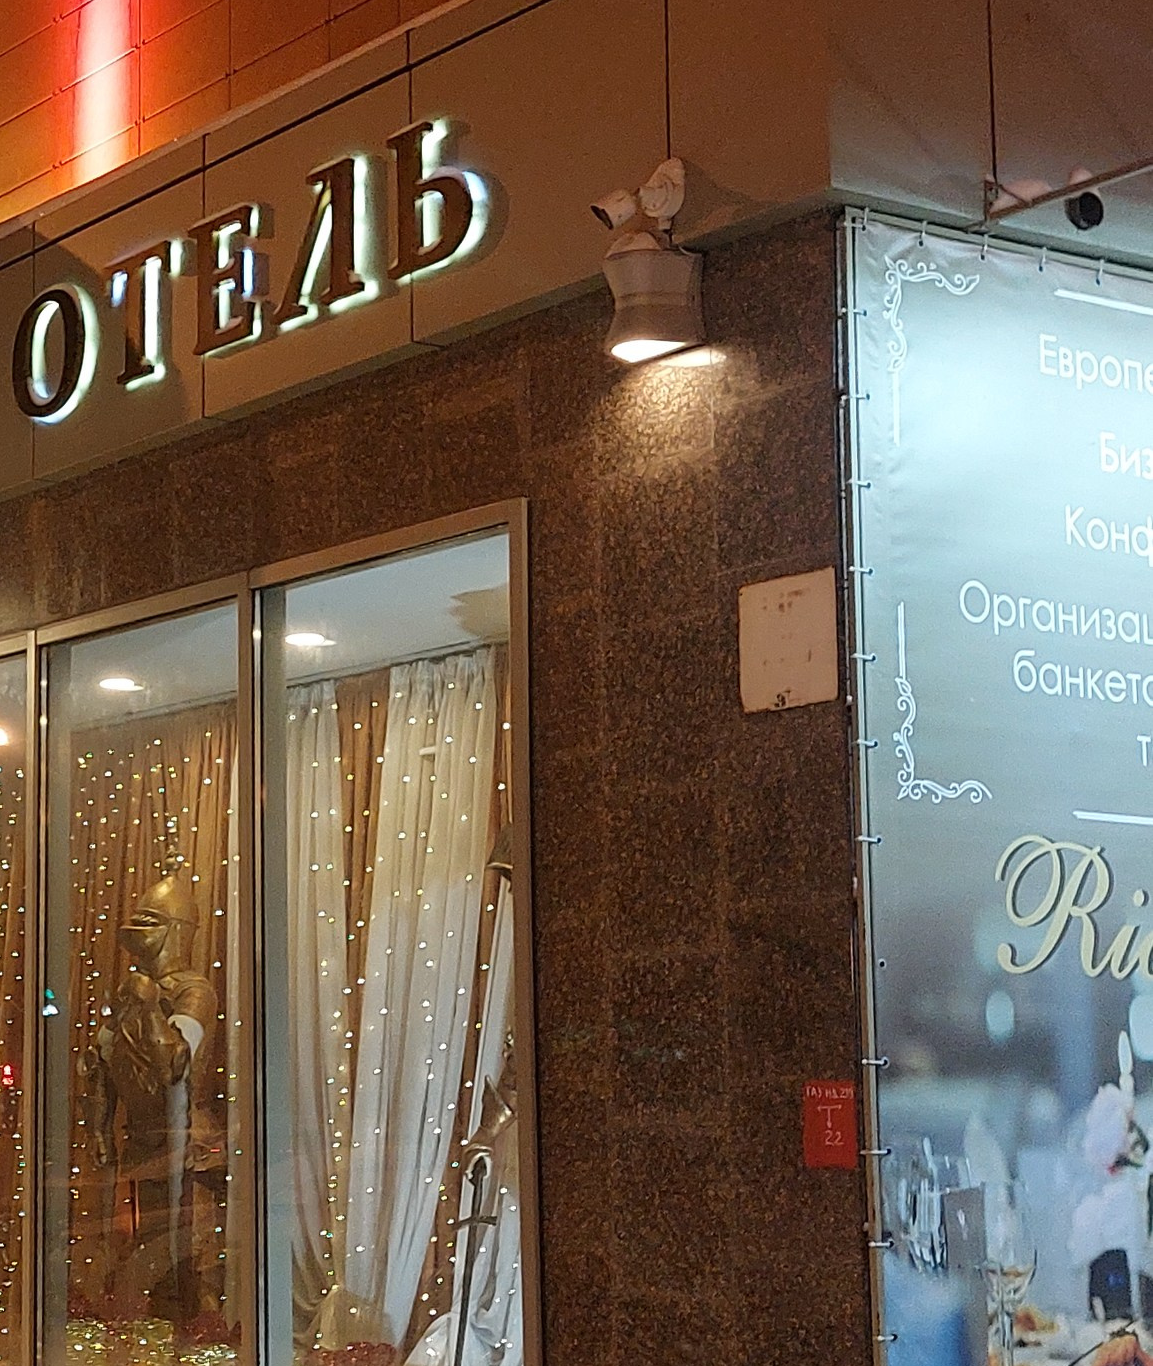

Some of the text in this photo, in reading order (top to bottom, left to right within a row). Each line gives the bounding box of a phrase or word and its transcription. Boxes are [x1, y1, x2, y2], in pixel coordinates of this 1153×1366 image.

[11, 118, 489, 424] ОТЕЛЬ
[1099, 431, 1153, 480] Биз
[825, 1130, 844, 1147] 22
